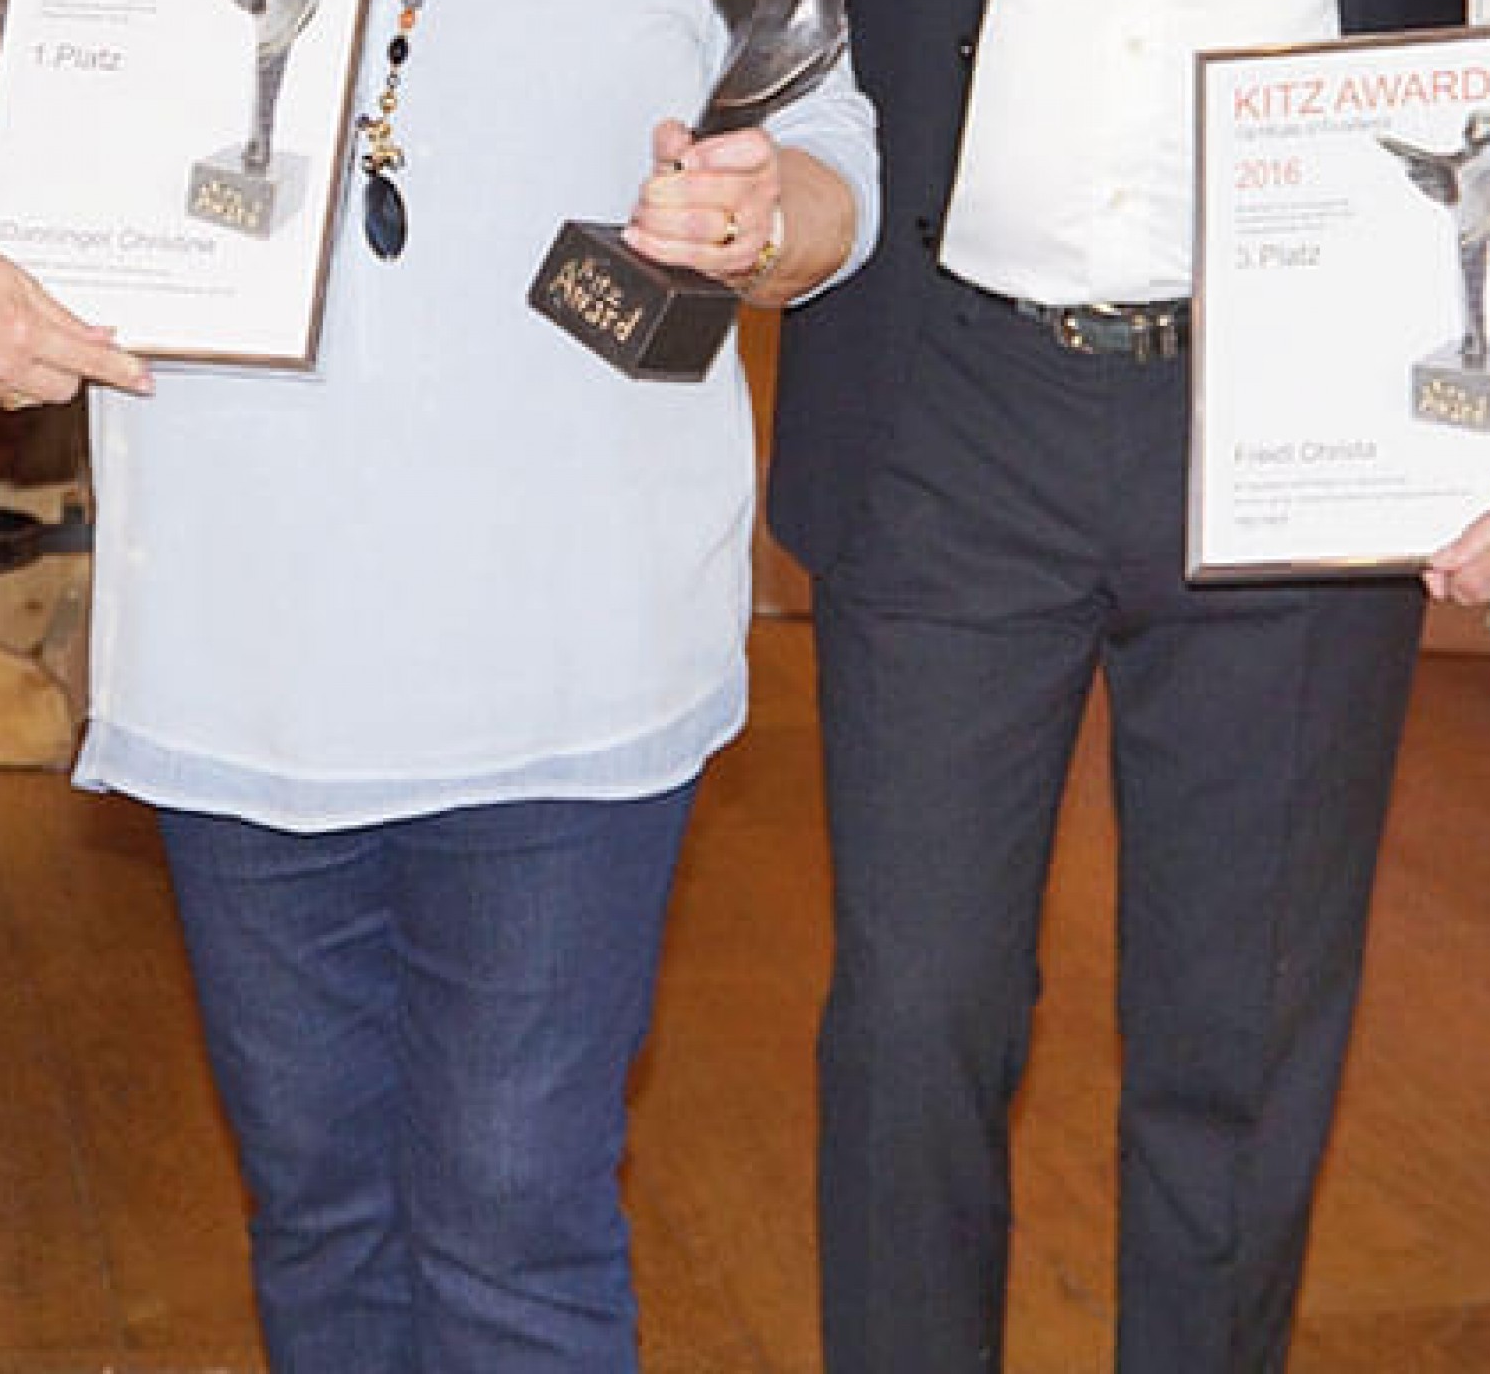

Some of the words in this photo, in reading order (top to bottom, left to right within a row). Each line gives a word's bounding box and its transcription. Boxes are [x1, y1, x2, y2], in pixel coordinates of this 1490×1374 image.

[1234, 80, 1324, 120] KITZ
[1334, 67, 1490, 111] AWARD
[1234, 156, 1303, 189] 2016
